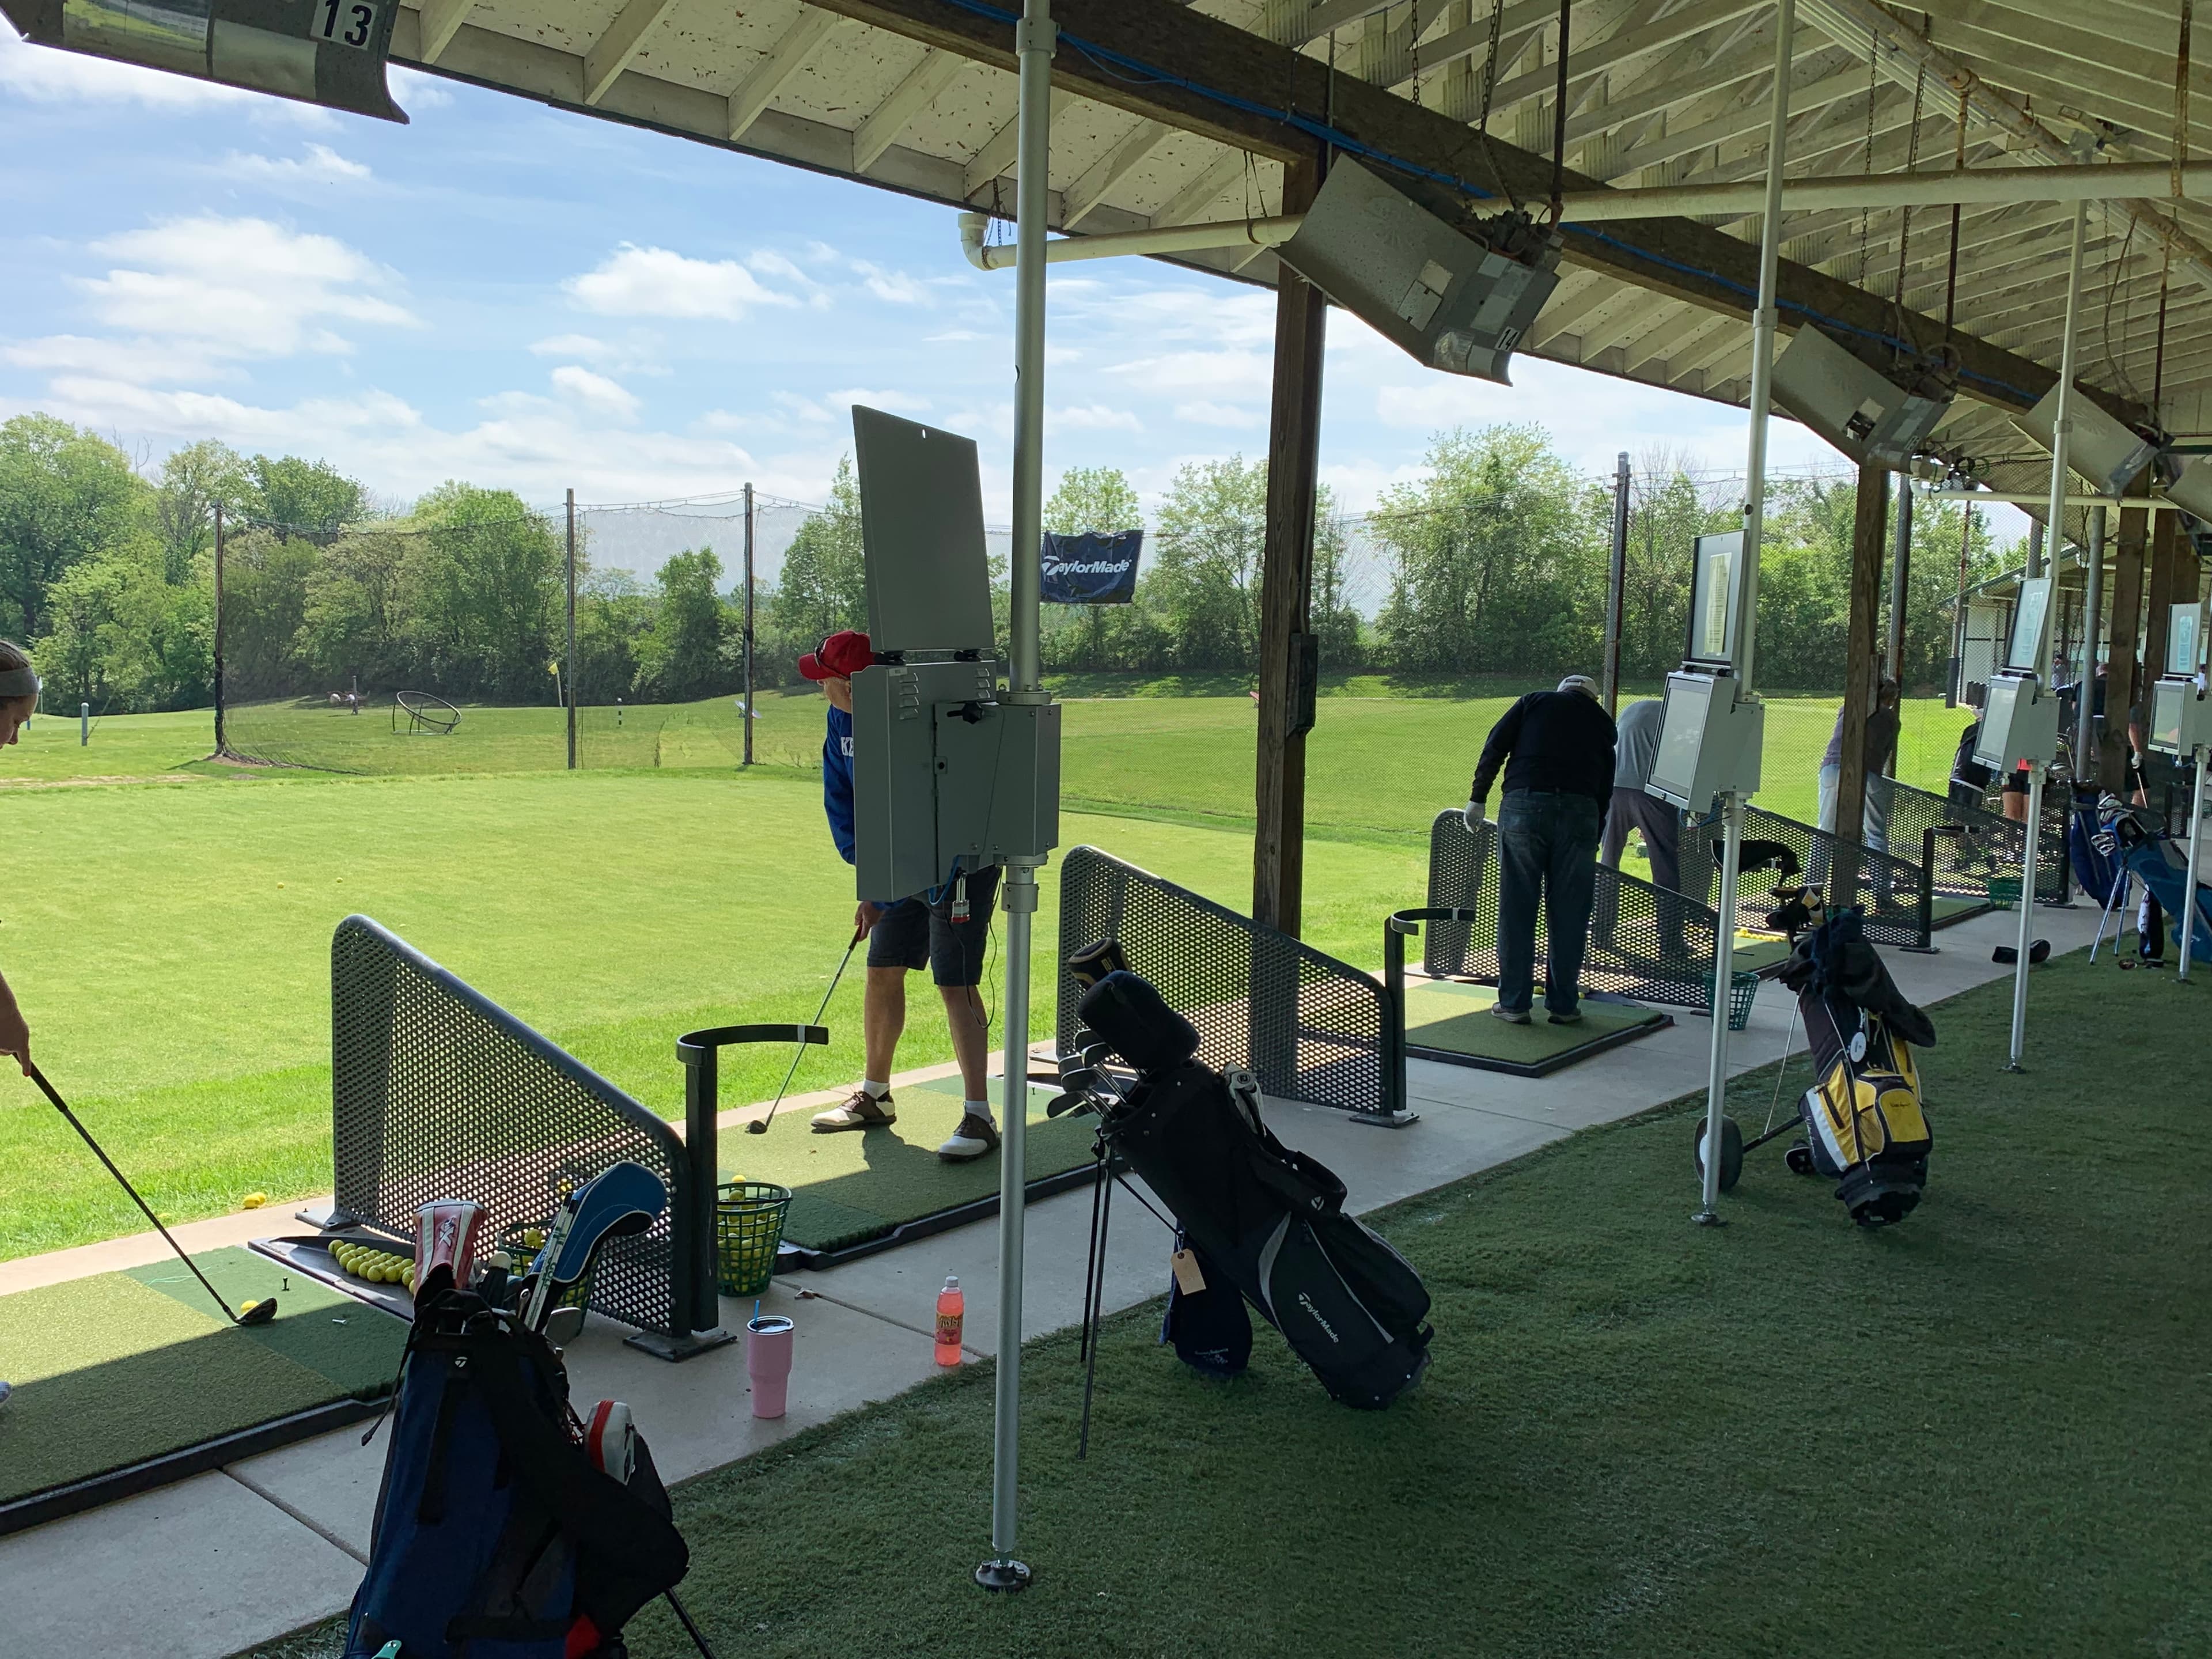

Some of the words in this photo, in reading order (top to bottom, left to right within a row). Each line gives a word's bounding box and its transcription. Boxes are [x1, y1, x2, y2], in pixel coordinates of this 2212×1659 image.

[324, 0, 372, 46] 13
[1498, 329, 1518, 350] 14
[1041, 555, 1130, 575] TaylorMade
[1299, 1292, 1339, 1343] TaylorMade
